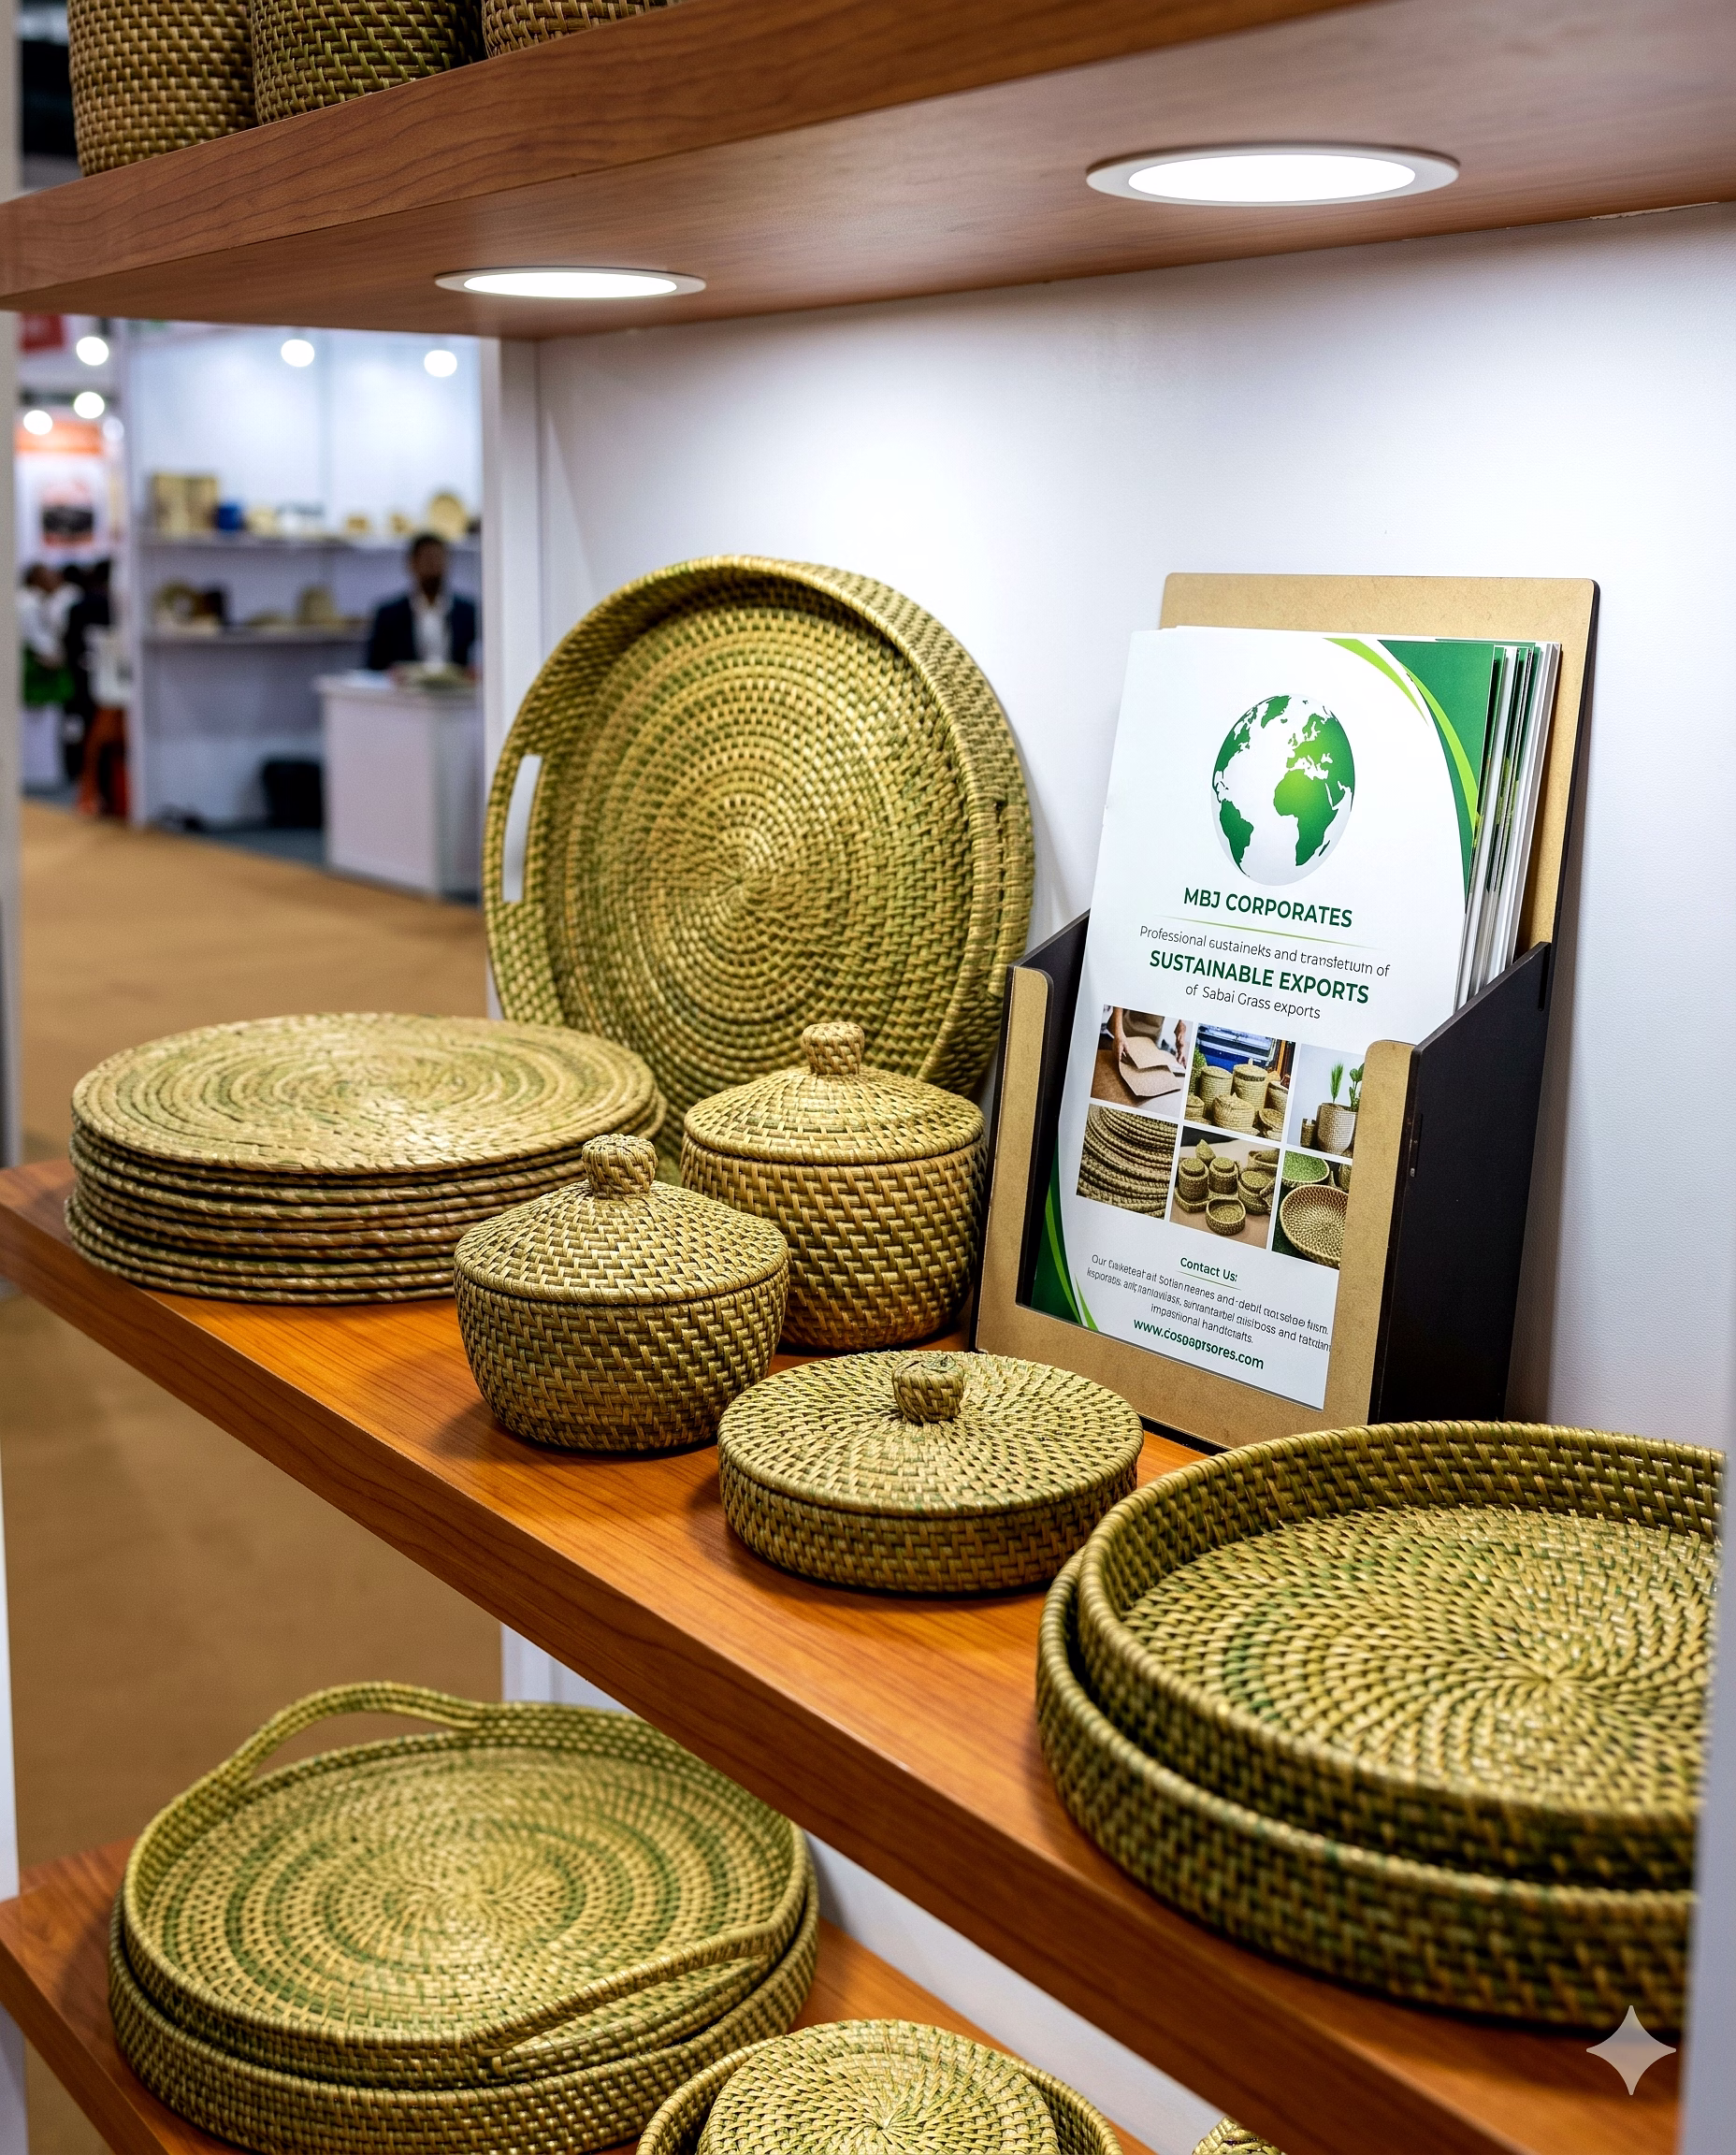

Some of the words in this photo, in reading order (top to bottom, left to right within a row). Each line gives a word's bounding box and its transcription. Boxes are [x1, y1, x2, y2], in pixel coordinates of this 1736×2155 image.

[1183, 888, 1221, 909] MBJ
[1225, 893, 1353, 928] CORPORATES
[1140, 925, 1207, 947] Professional
[1274, 947, 1297, 962] and
[1376, 964, 1391, 977] of
[1150, 950, 1274, 987] SUSTAINABLE
[1279, 972, 1369, 1004] EXPORTS
[1185, 984, 1198, 996] of
[1202, 986, 1235, 1004] Sabai
[1237, 992, 1271, 1010] Grass
[1274, 1002, 1321, 1020] exports
[1092, 1254, 1107, 1266] Our
[1180, 1257, 1220, 1278] Contact
[1222, 1269, 1238, 1281] Us:
[1278, 1328, 1296, 1341] and
